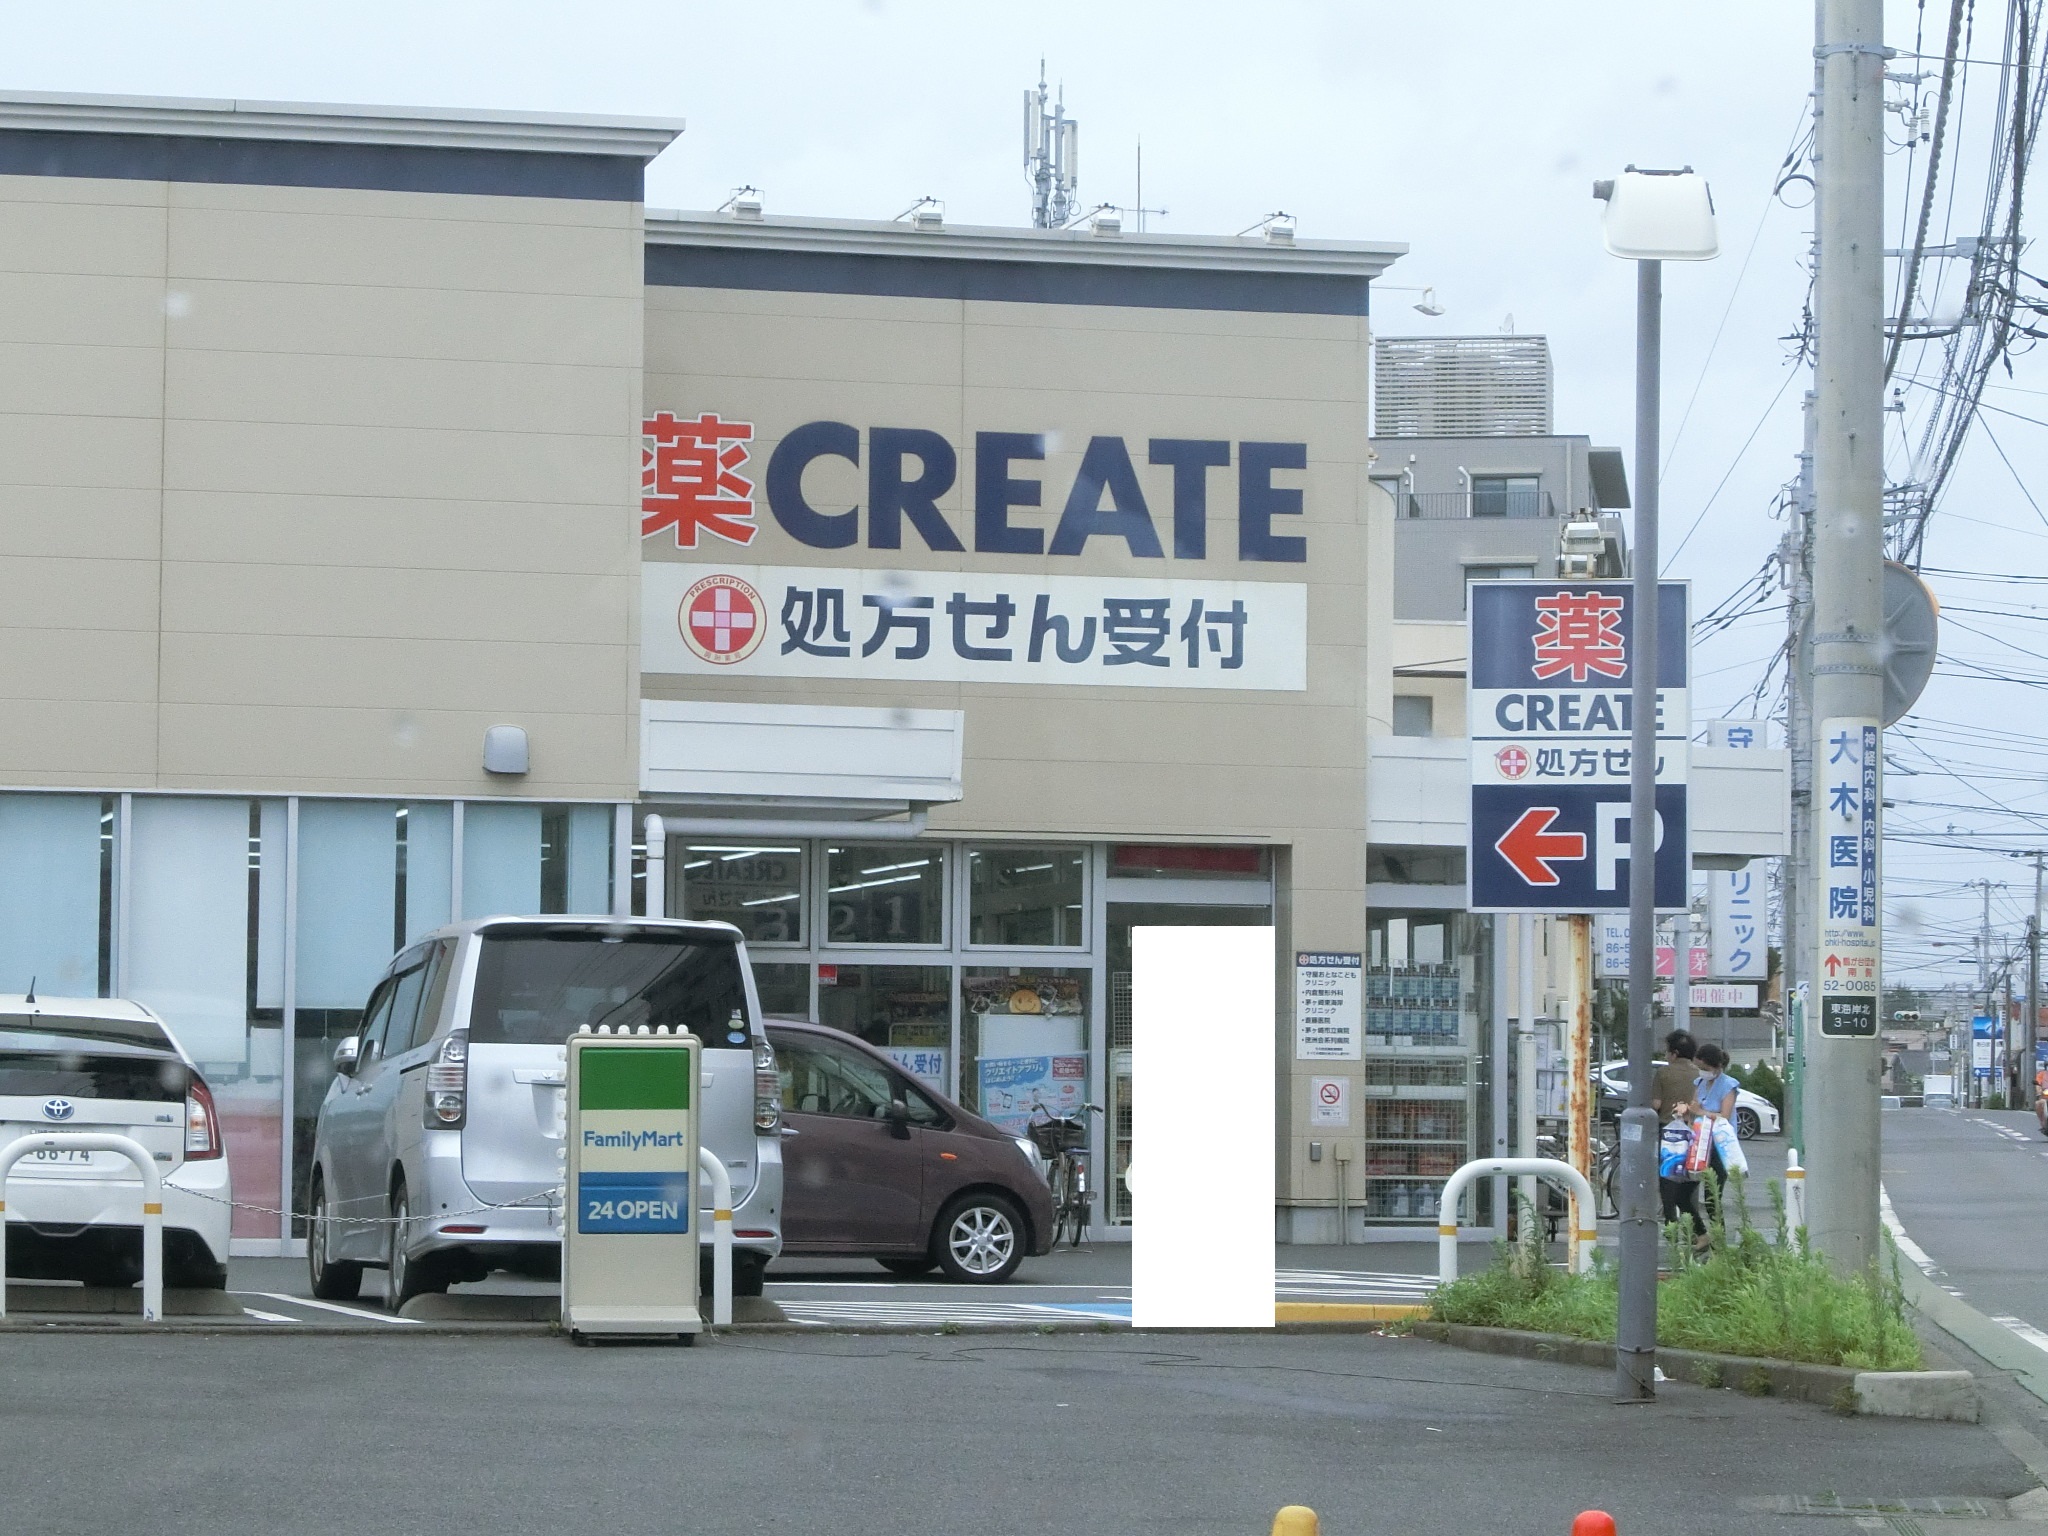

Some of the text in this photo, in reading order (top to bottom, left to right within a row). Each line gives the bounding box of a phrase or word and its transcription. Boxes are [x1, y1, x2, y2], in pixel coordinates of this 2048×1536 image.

[641, 410, 1308, 563] 薬 CREATE
[689, 577, 756, 600] PRESCRIPTION
[780, 585, 1248, 670] 処方せん受付
[1532, 591, 1628, 683] 薬
[1595, 801, 1665, 892] P
[1829, 730, 1860, 920] 大木医院
[1862, 731, 1877, 922] 神経内科・内科・小児科
[1728, 871, 1755, 973] リニック
[1309, 955, 1360, 966] 処方せん受付
[1823, 980, 1876, 992] 52-0085
[1691, 988, 1743, 1004] 開催中
[1830, 1003, 1871, 1015] 東海岸北
[583, 1130, 684, 1152] FamilyMart
[588, 1200, 678, 1220] 24 OPEN
